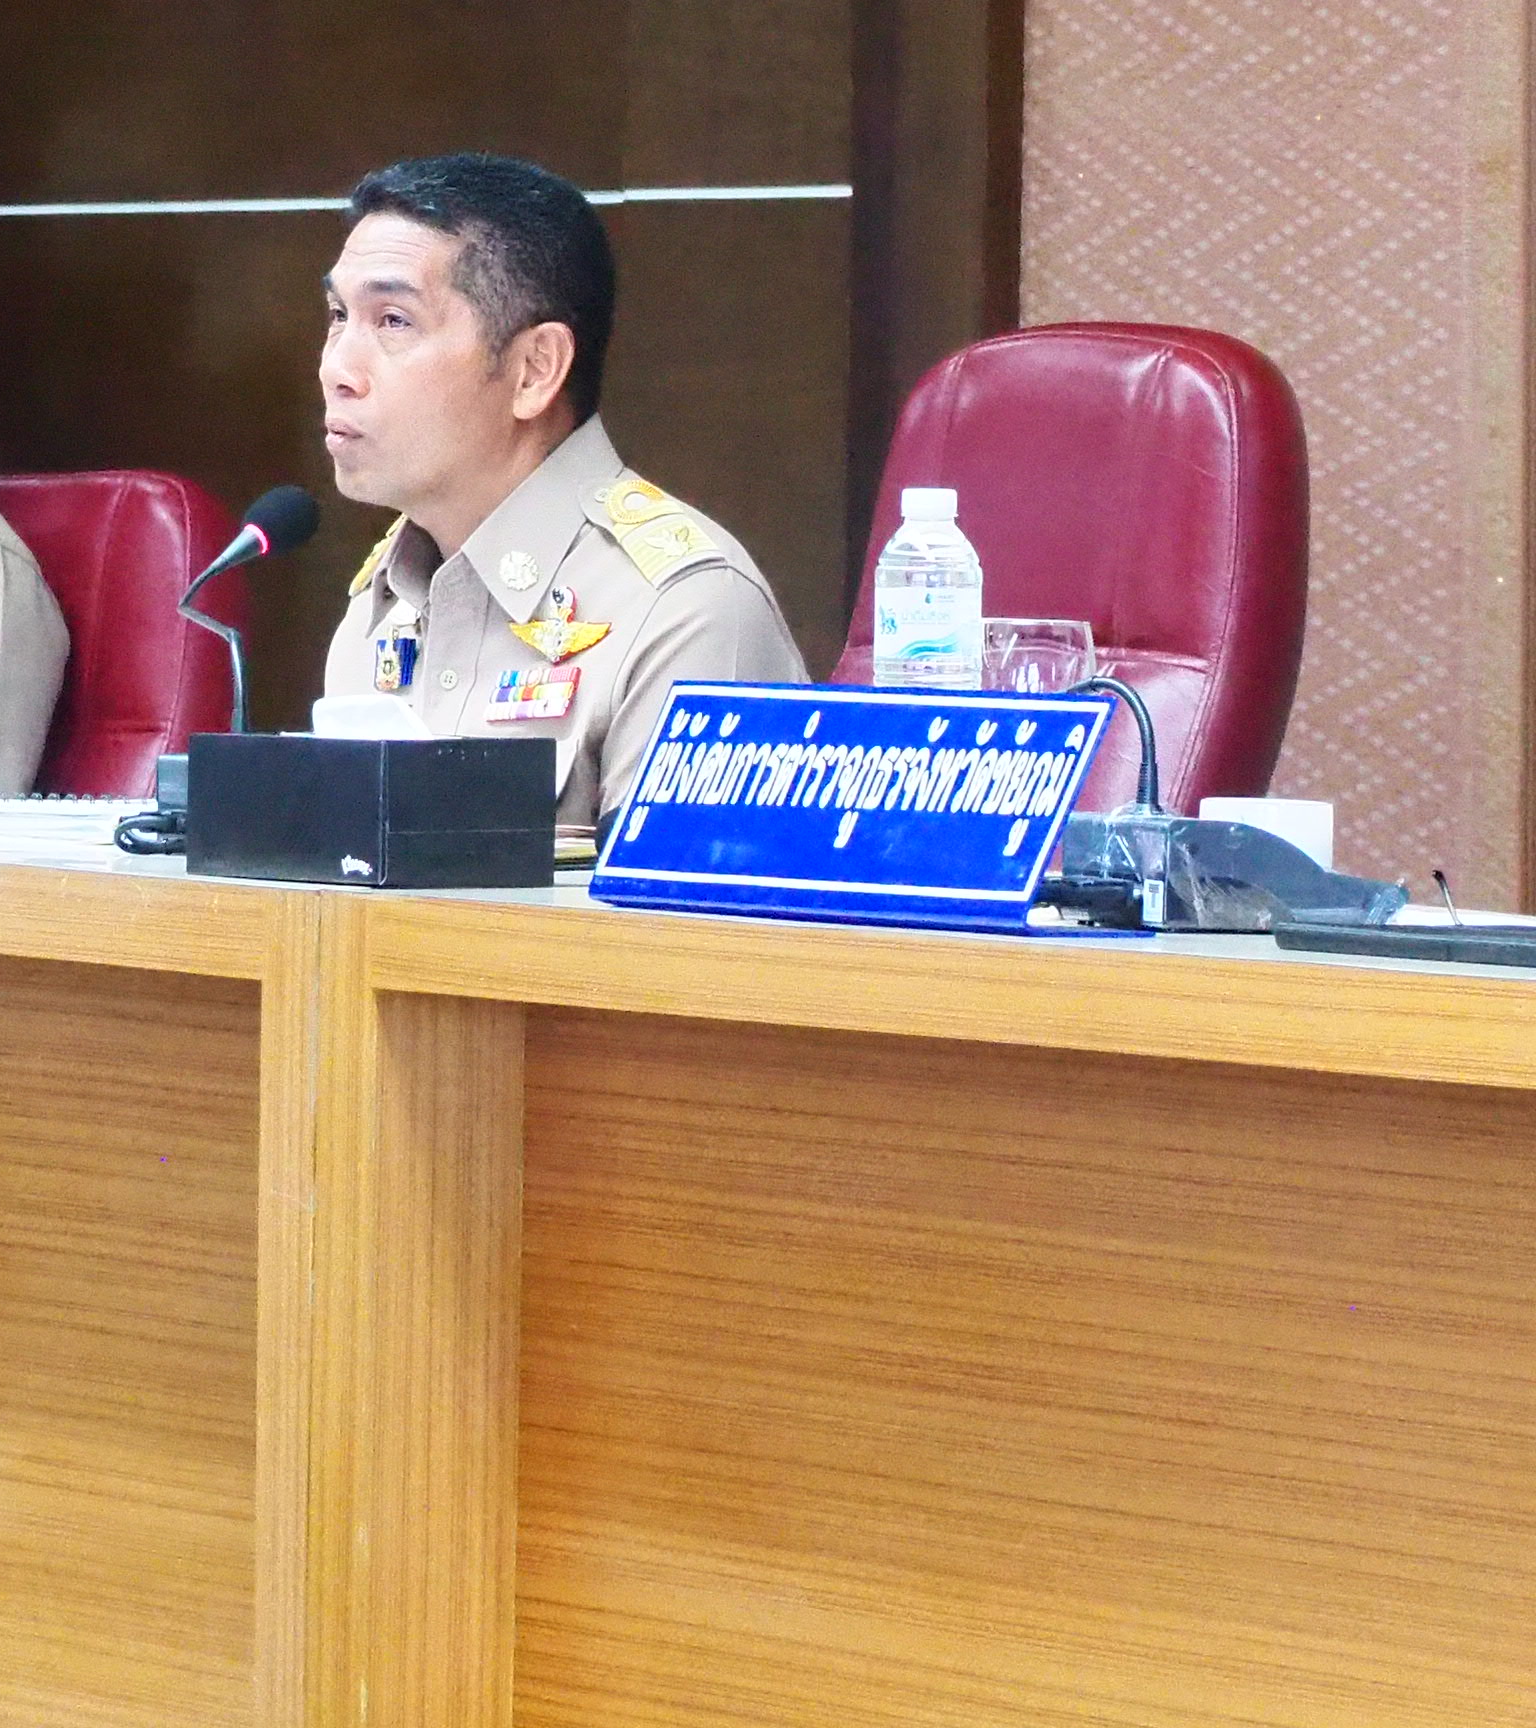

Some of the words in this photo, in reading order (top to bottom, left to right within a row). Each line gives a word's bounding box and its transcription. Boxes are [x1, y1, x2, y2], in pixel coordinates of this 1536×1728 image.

[625, 709, 1085, 856] ผู้บังคับการตำรวจภูธรจังหวัดชัยภูมิ
